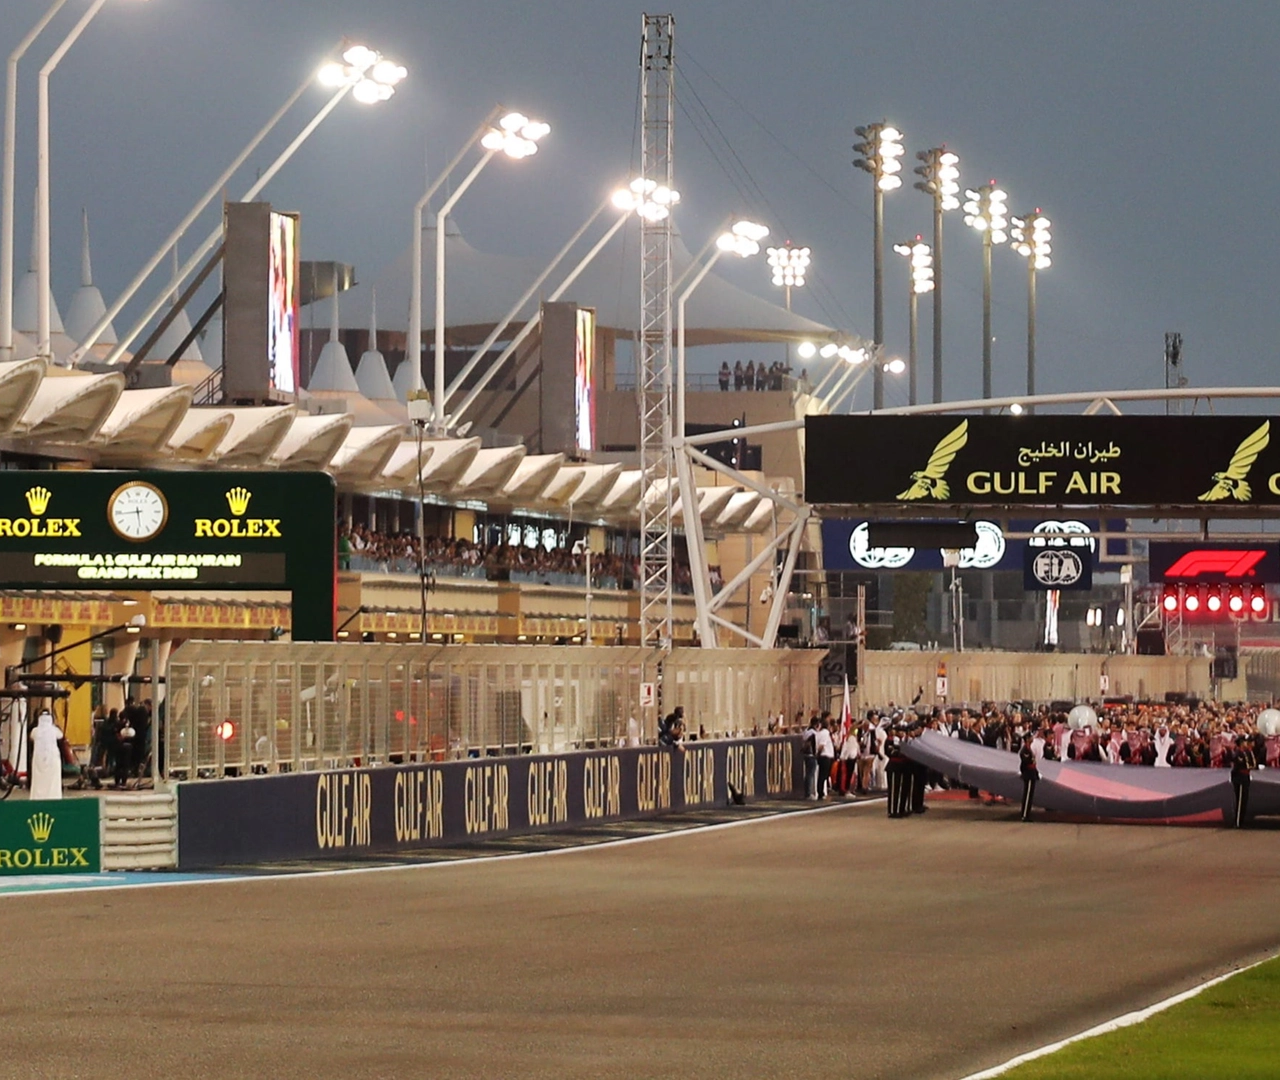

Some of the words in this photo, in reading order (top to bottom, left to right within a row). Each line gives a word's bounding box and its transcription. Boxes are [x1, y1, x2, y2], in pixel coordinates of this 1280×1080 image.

[1017, 441, 1070, 467] الخليج
[1073, 441, 1121, 464] طيران
[966, 471, 1057, 495] GULF
[1065, 471, 1121, 495] AIR
[194, 518, 281, 537] ROLEX
[34, 554, 104, 566] FORMULA
[114, 554, 151, 566] GULF
[176, 554, 241, 567] BAHRAIN
[77, 566, 129, 579] GRAND
[128, 566, 163, 579] PRIX
[465, 767, 491, 834] GULF
[492, 764, 509, 830] AIR
[528, 762, 552, 826] GULF
[552, 759, 567, 822] AIR
[584, 757, 606, 819] GULF
[606, 755, 620, 816] AIR
[637, 753, 658, 811] GULF
[658, 751, 671, 809] AIR
[684, 749, 702, 805] GULF
[703, 747, 714, 802] AIR
[317, 774, 349, 848] GULF
[351, 771, 371, 846] AIR
[395, 771, 424, 842] GULF
[425, 769, 443, 839] AIR
